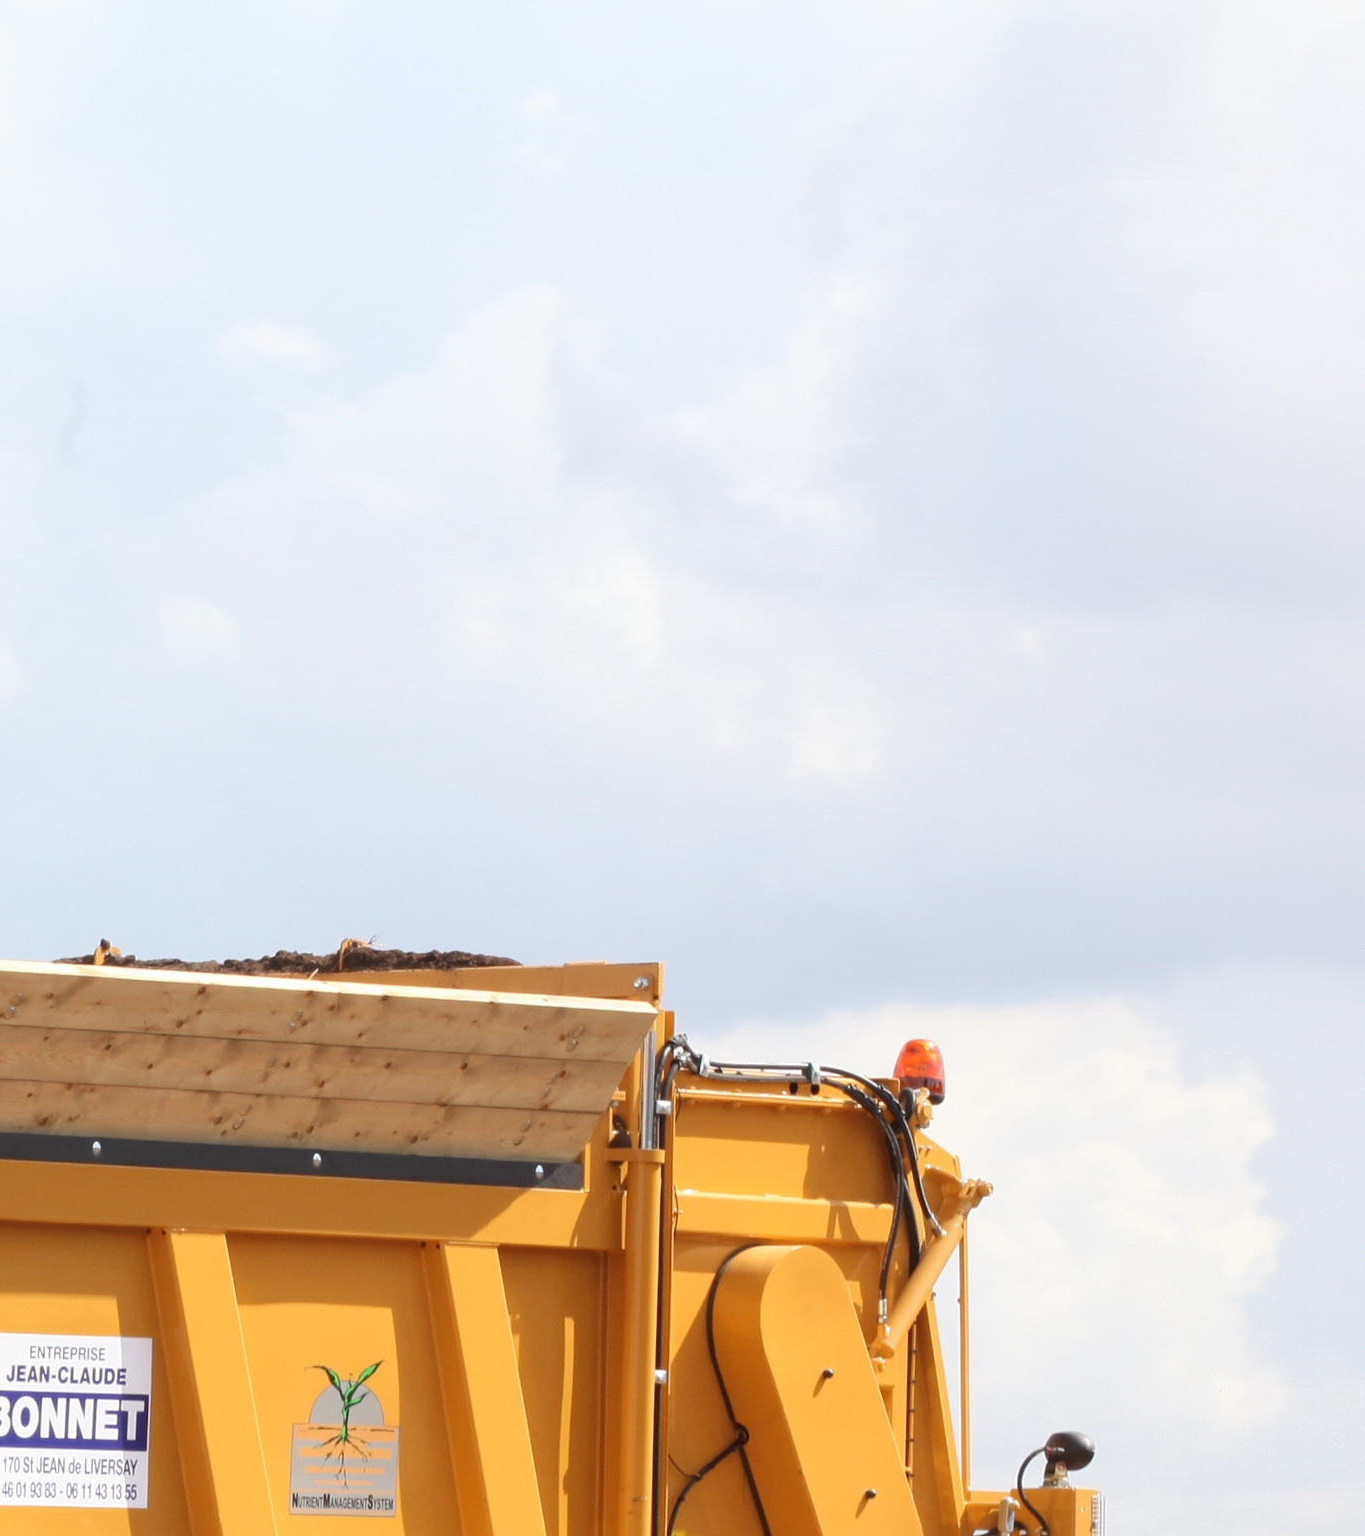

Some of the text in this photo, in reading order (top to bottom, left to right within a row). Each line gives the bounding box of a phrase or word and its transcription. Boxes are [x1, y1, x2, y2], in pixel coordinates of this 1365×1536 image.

[29, 1345, 106, 1361] ENTREPRISE
[6, 1365, 127, 1386] JEAN-CLAUDE
[3, 1456, 21, 1473] 170
[23, 1456, 34, 1474] St
[36, 1457, 66, 1474] JEAN
[68, 1458, 82, 1474] de
[84, 1458, 138, 1476] LIVERSAY
[2, 1481, 14, 1498] 46
[15, 1481, 27, 1499] 01
[30, 1482, 42, 1499] 93
[44, 1482, 57, 1499] 83
[66, 1483, 78, 1500] 06
[82, 1483, 92, 1500] 11
[95, 1484, 108, 1500] 43
[111, 1484, 123, 1500] 13
[125, 1484, 138, 1500] 55
